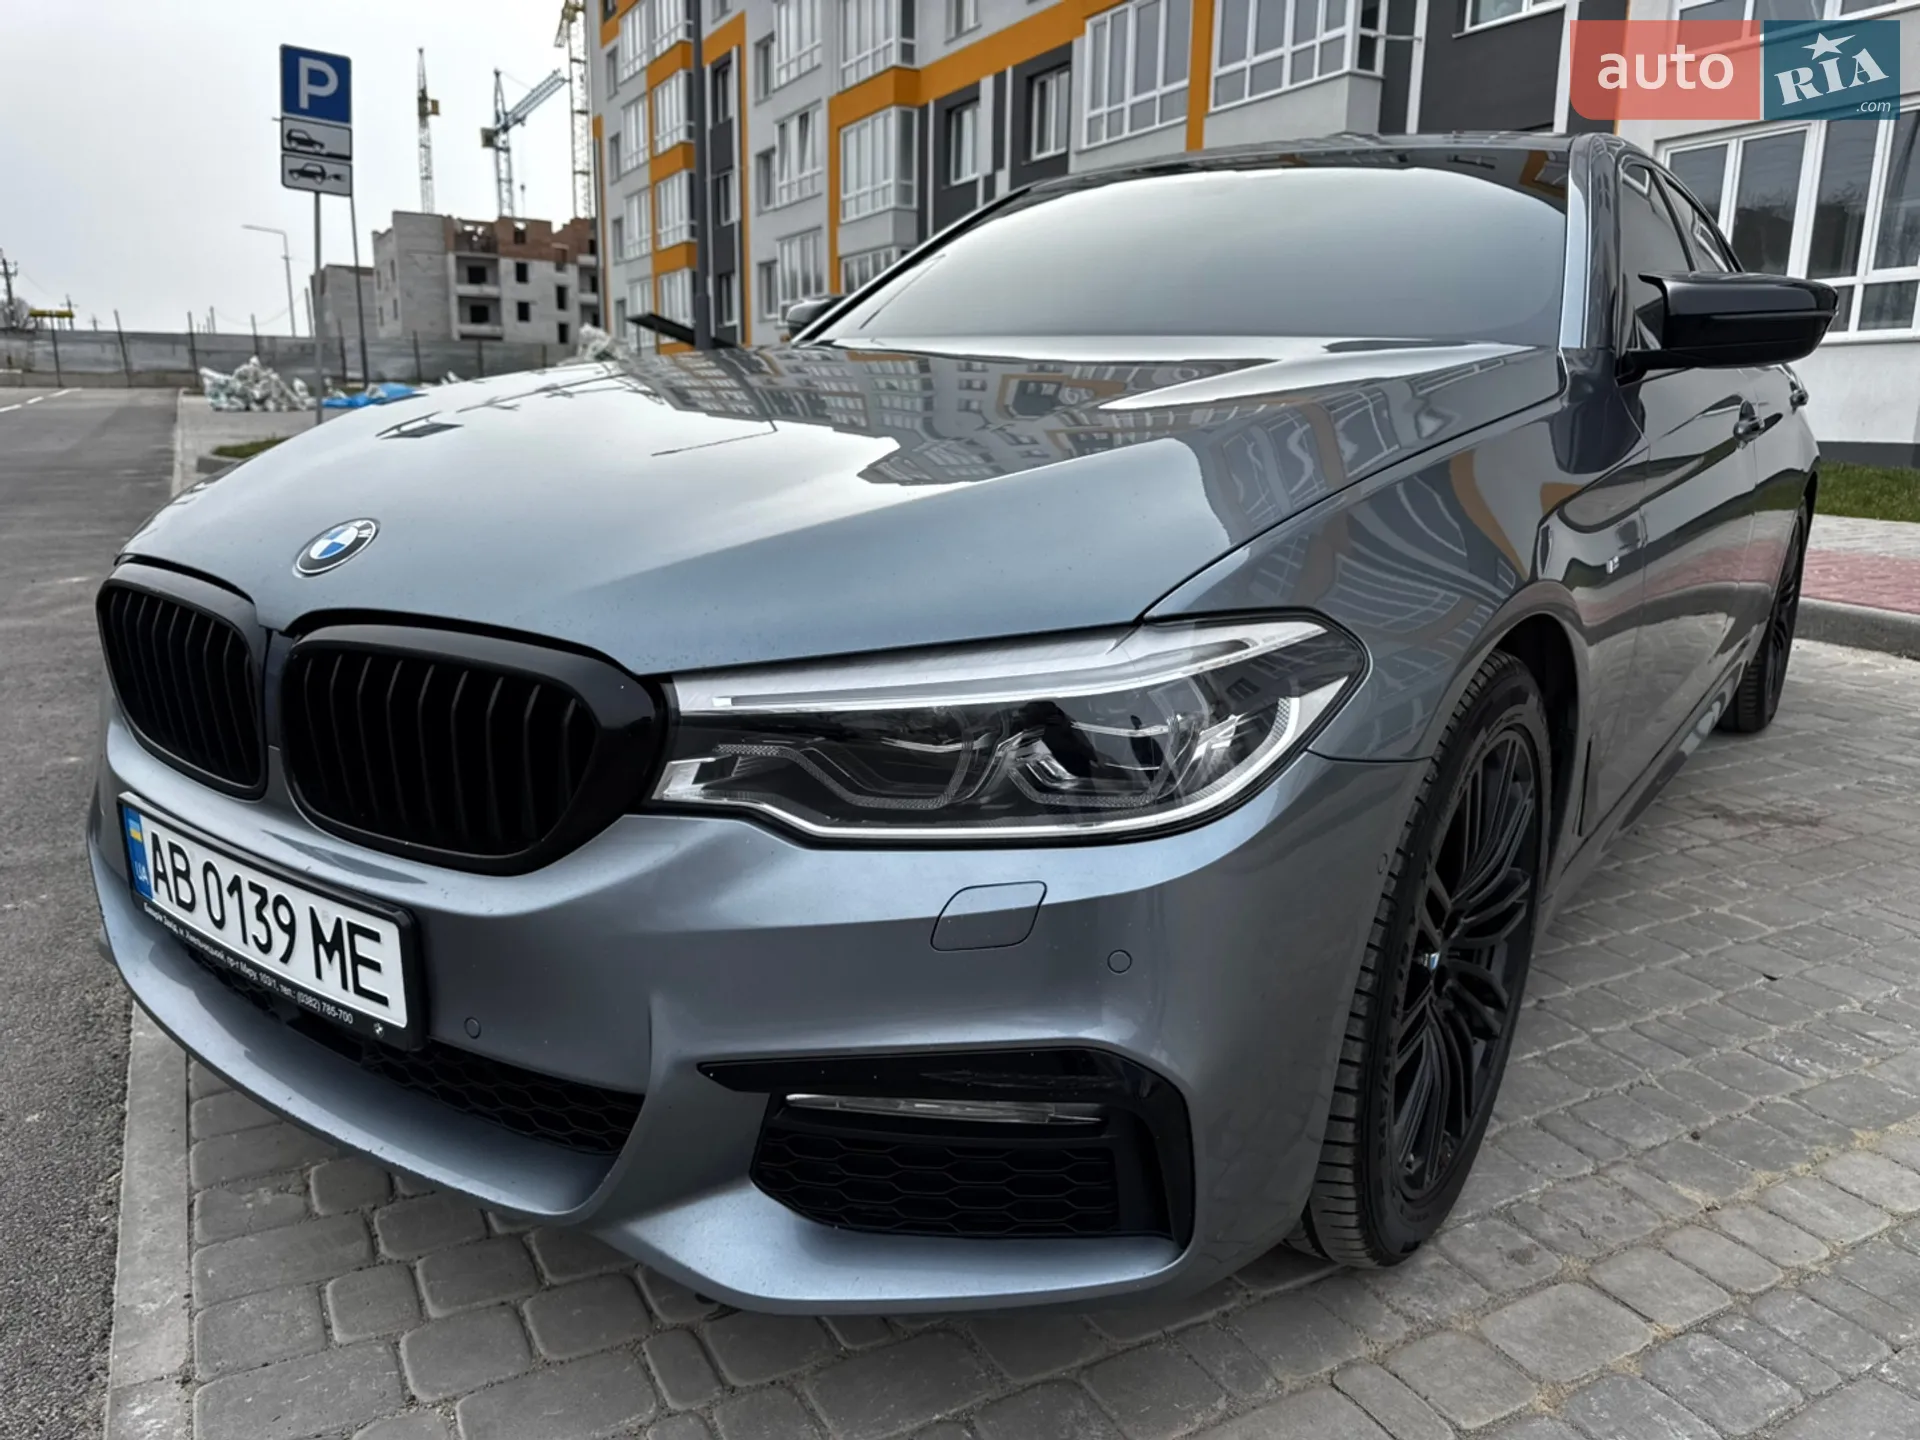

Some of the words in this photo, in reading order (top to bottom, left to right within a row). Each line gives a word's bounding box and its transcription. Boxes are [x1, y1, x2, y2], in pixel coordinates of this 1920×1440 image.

[298, 56, 339, 110] P
[134, 860, 149, 885] UA
[151, 831, 196, 913] AB
[202, 861, 296, 964] 0139
[309, 905, 389, 1008] ME
[321, 1001, 354, 1024] 785-700
